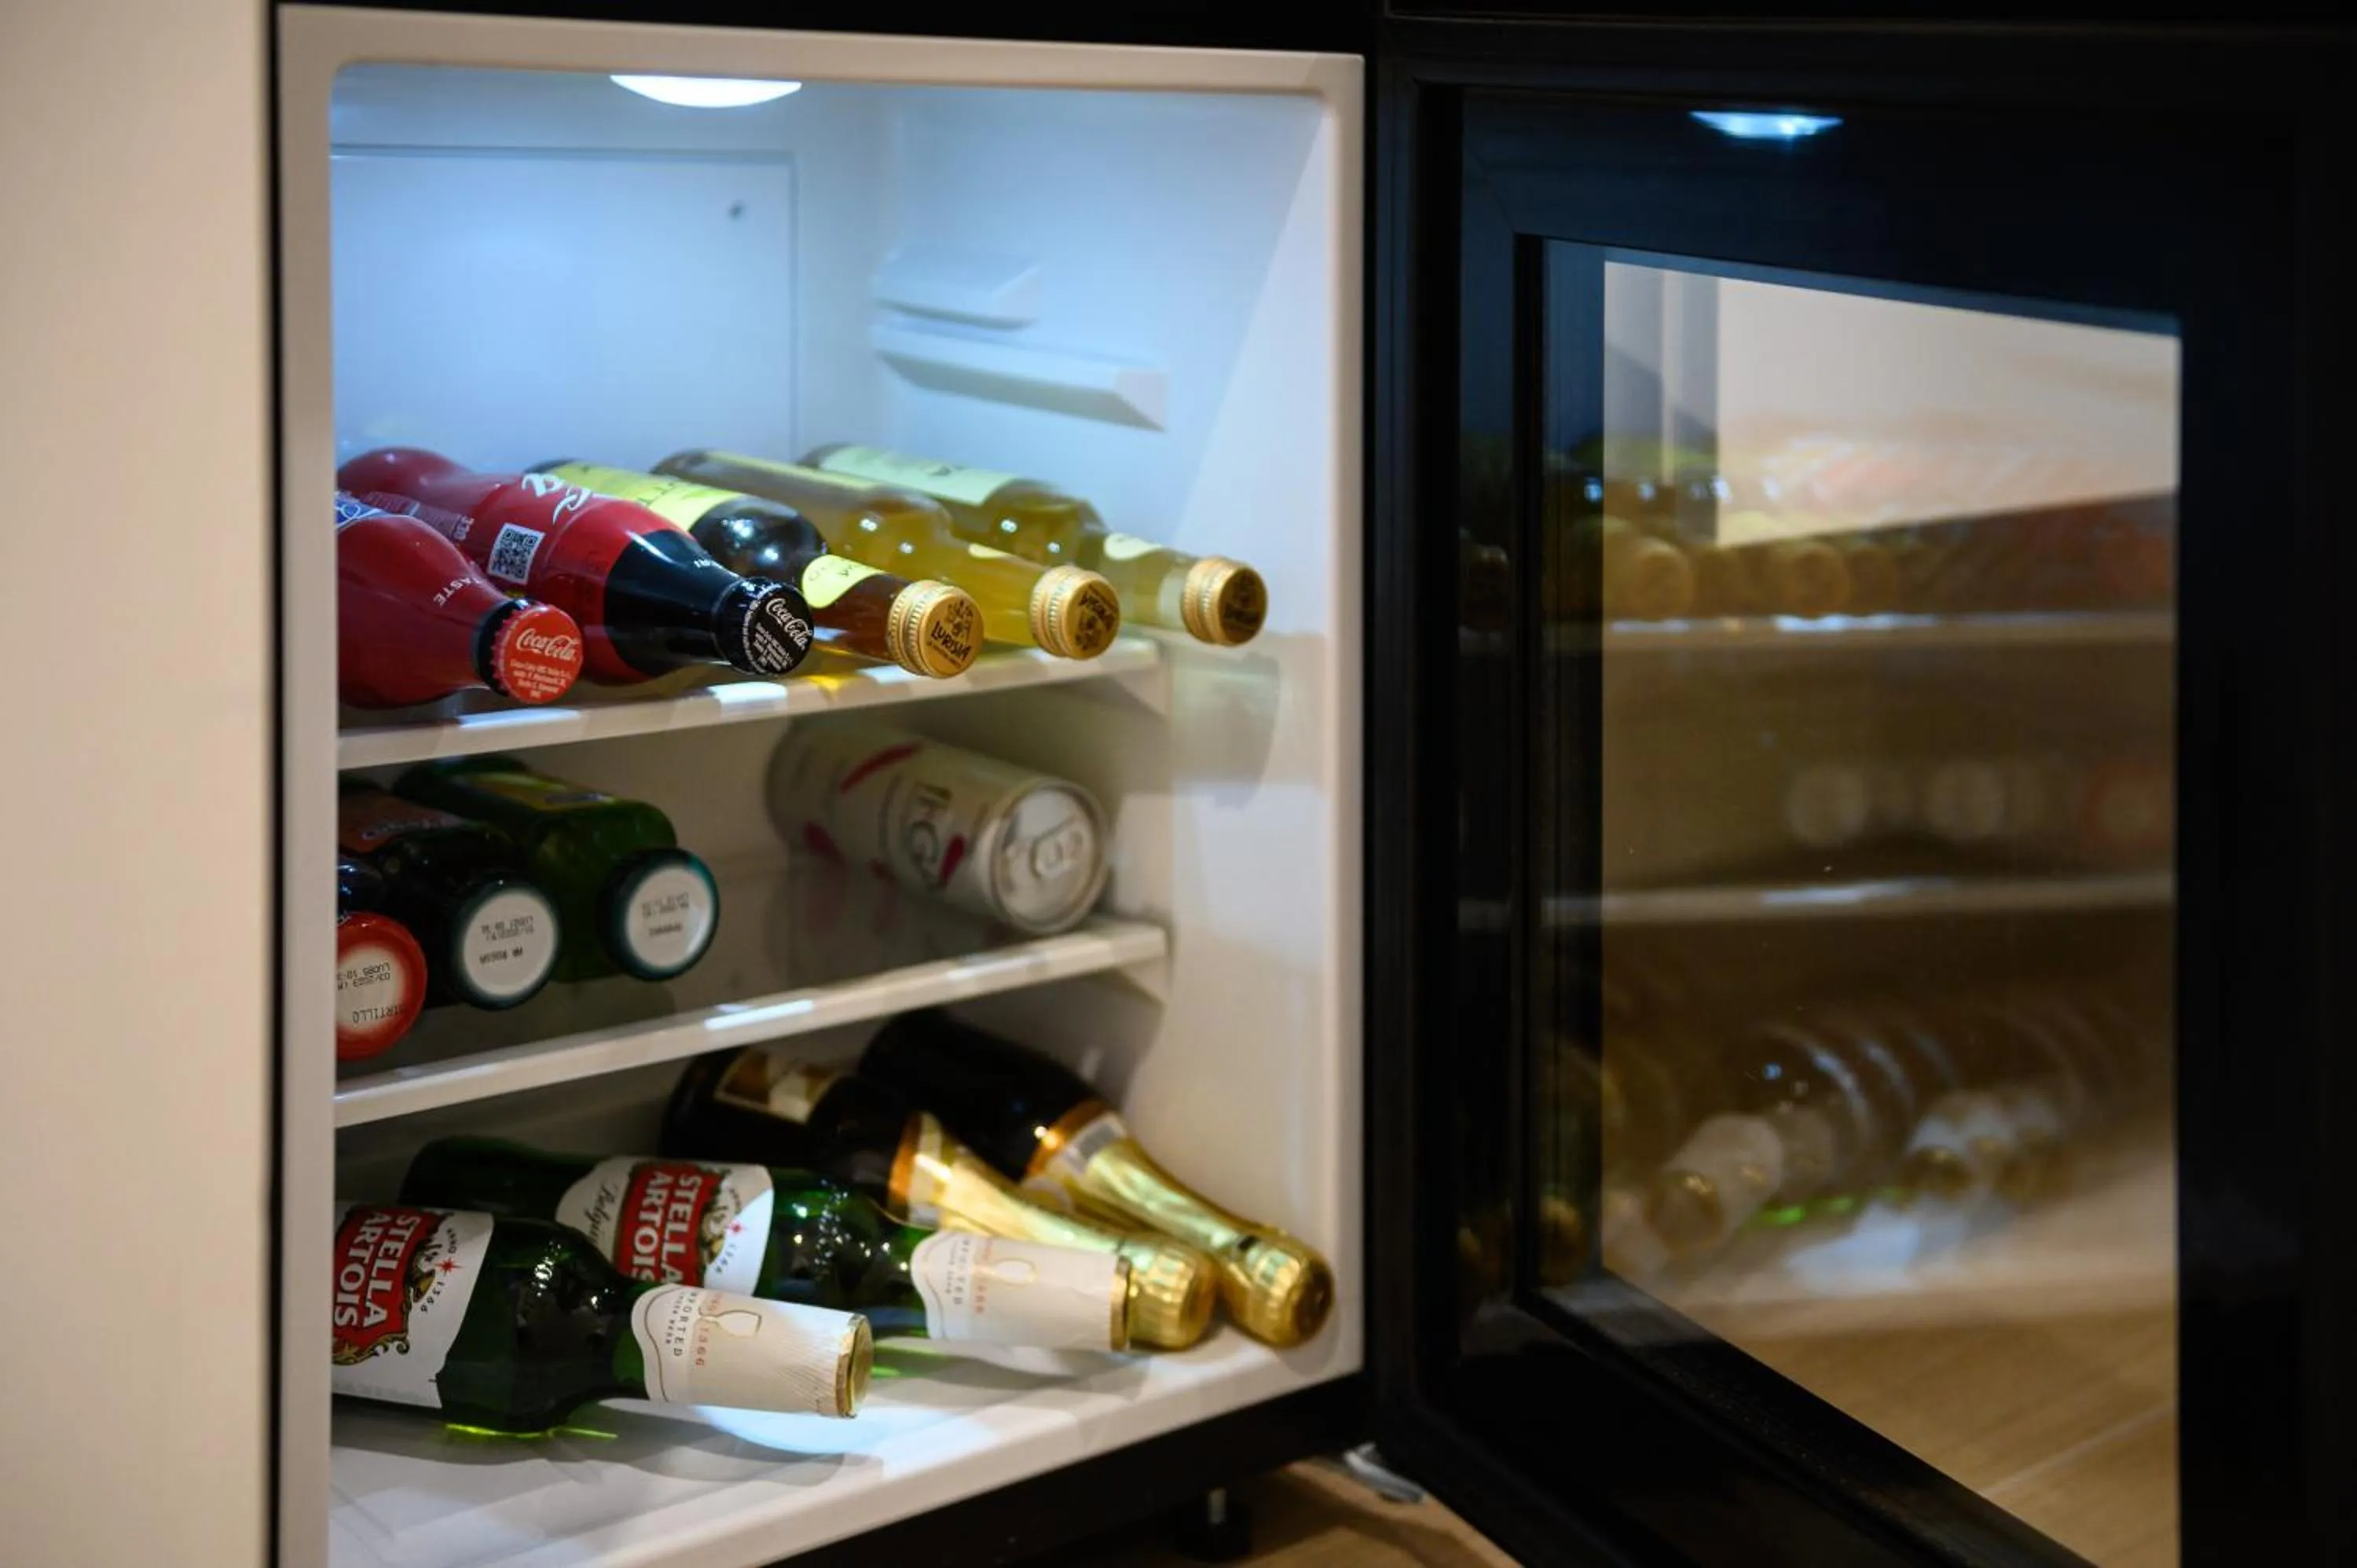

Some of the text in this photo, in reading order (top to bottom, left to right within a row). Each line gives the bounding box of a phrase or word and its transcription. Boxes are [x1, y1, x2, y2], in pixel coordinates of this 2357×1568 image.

[334, 1212, 392, 1326] ARTOIS
[362, 1214, 421, 1328] STELLA
[631, 1171, 674, 1282] ARTOIS
[661, 1174, 702, 1284] STELLA
